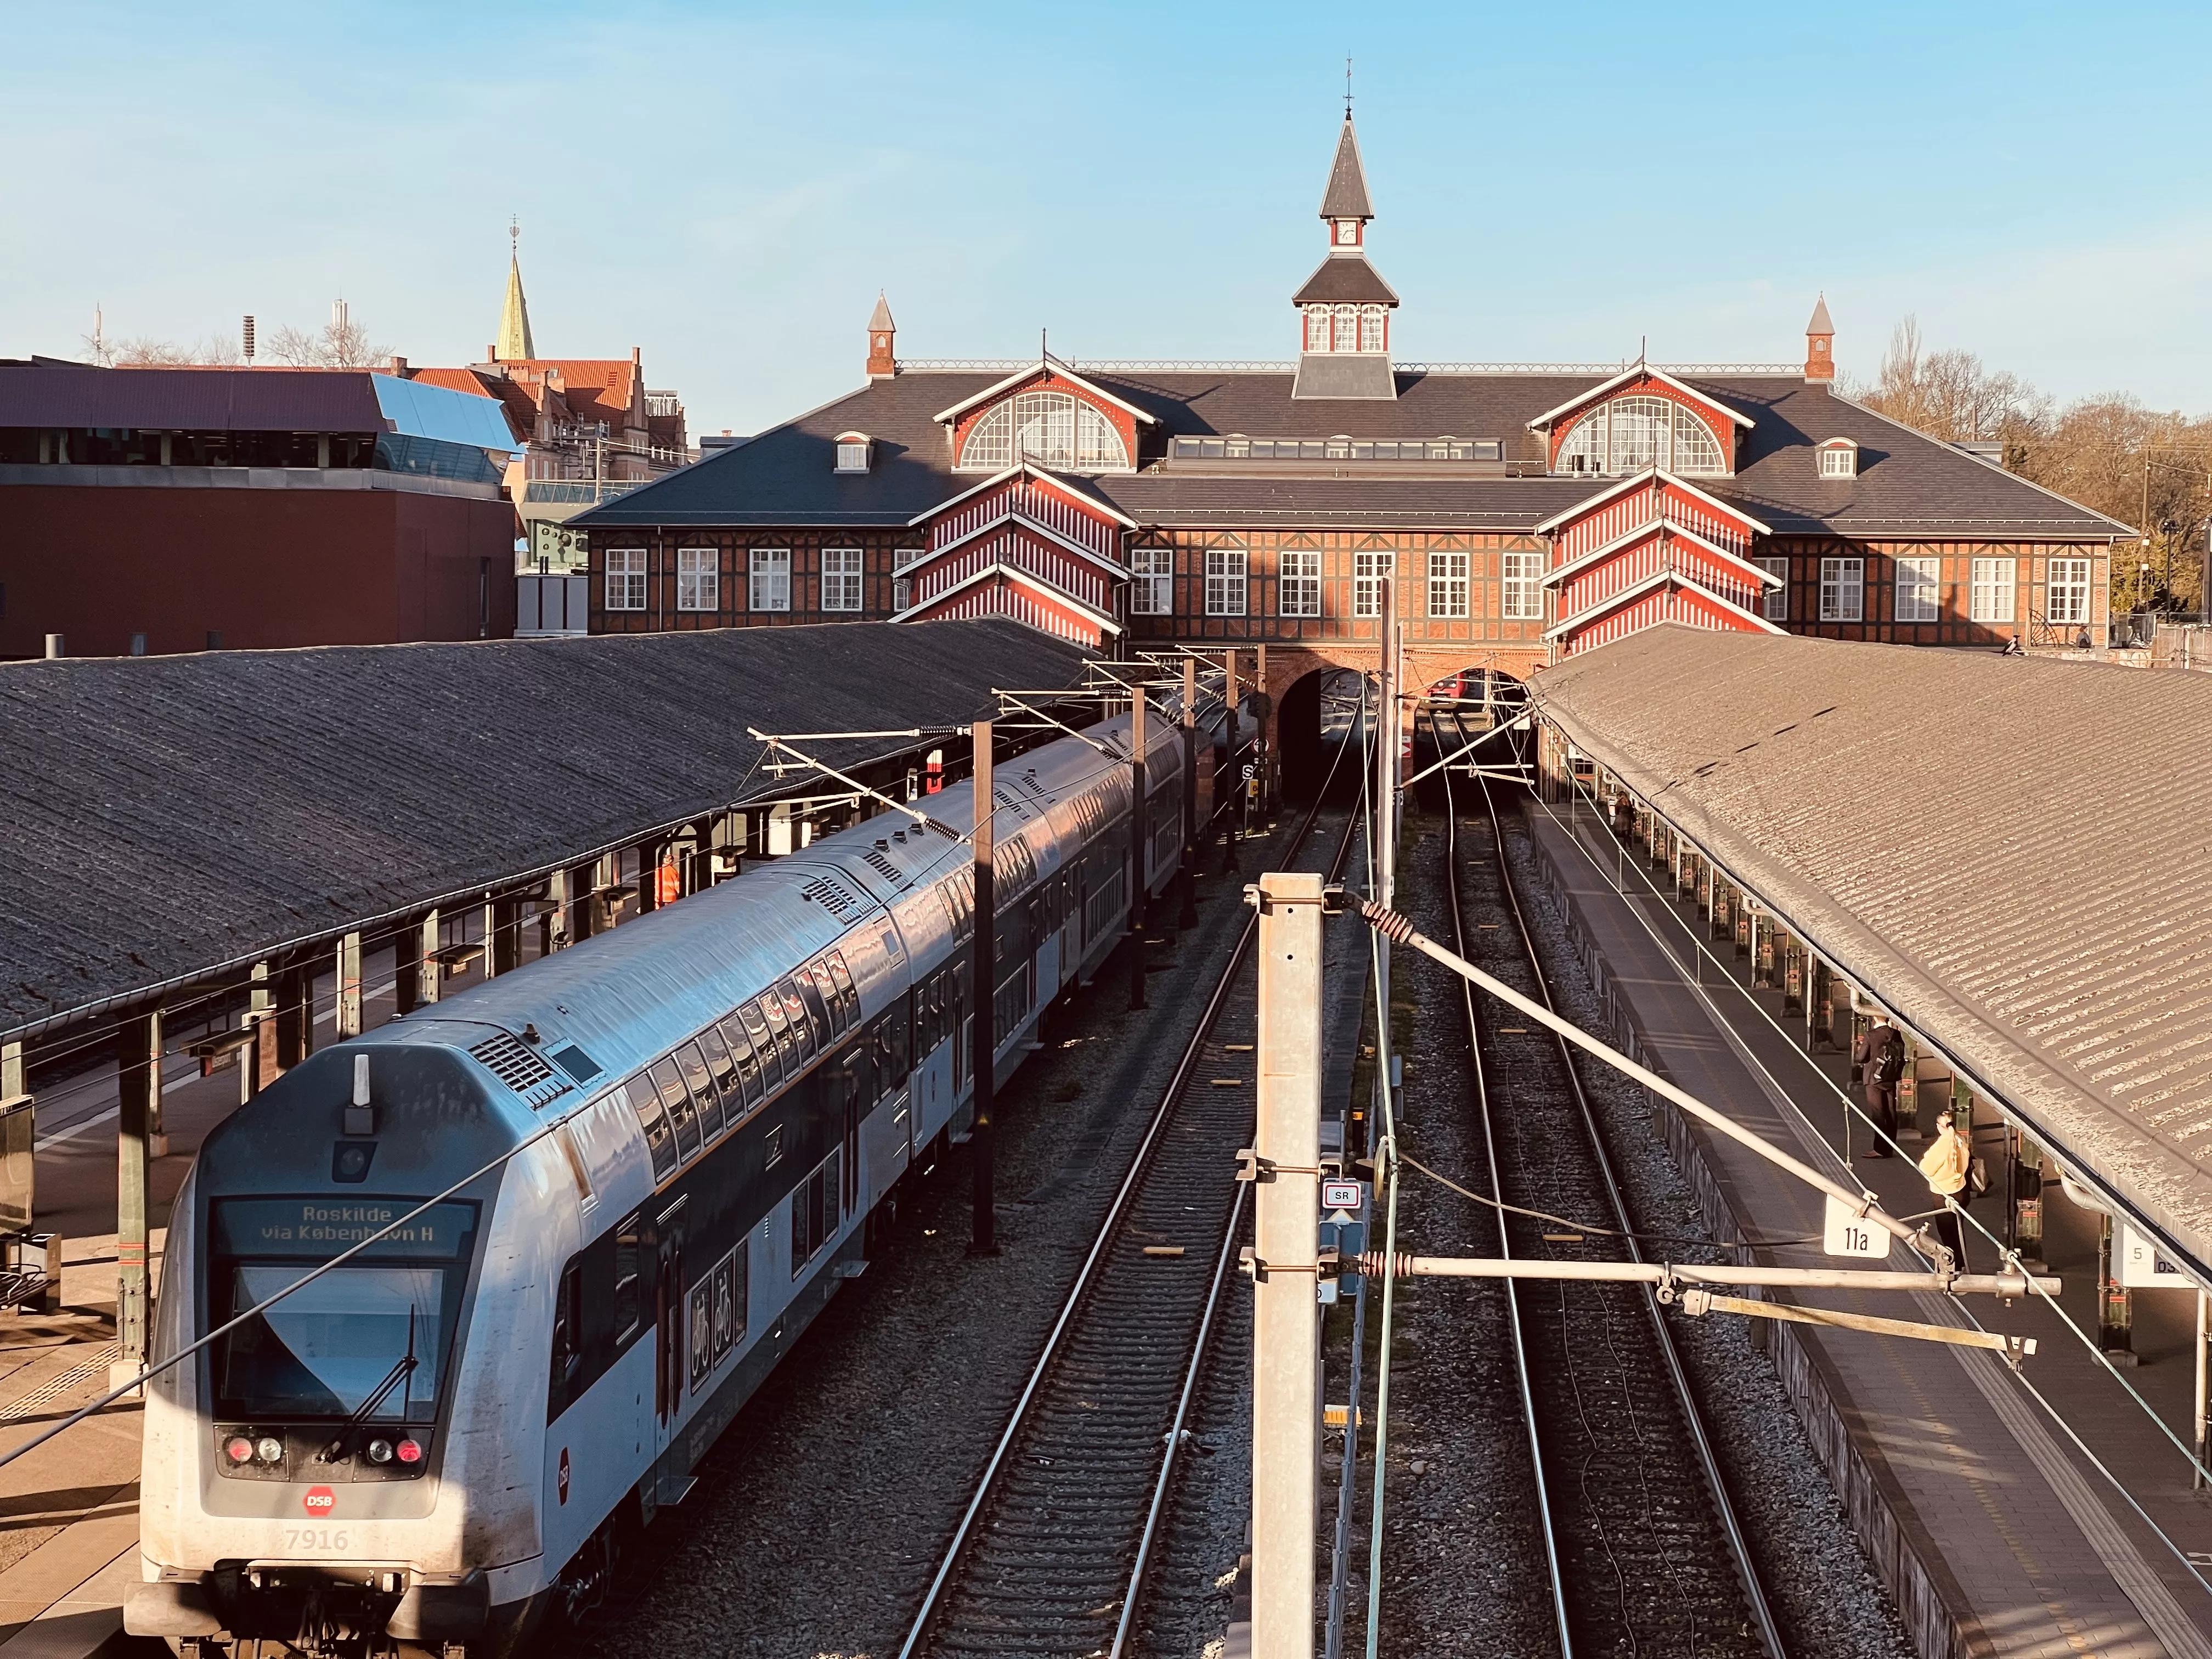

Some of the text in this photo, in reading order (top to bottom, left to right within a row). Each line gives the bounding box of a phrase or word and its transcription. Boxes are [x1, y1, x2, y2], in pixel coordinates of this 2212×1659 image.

[1243, 766, 1253, 778] S
[1335, 1192, 1349, 1200] SR
[303, 1207, 391, 1222] Roskilde
[262, 1226, 292, 1240] via
[421, 1227, 432, 1241] H
[1846, 1227, 1867, 1251] 11a
[2134, 1248, 2142, 1260] 5
[560, 1465, 568, 1488] DSB
[307, 1496, 332, 1507] DSB
[286, 1530, 348, 1550] 7916
